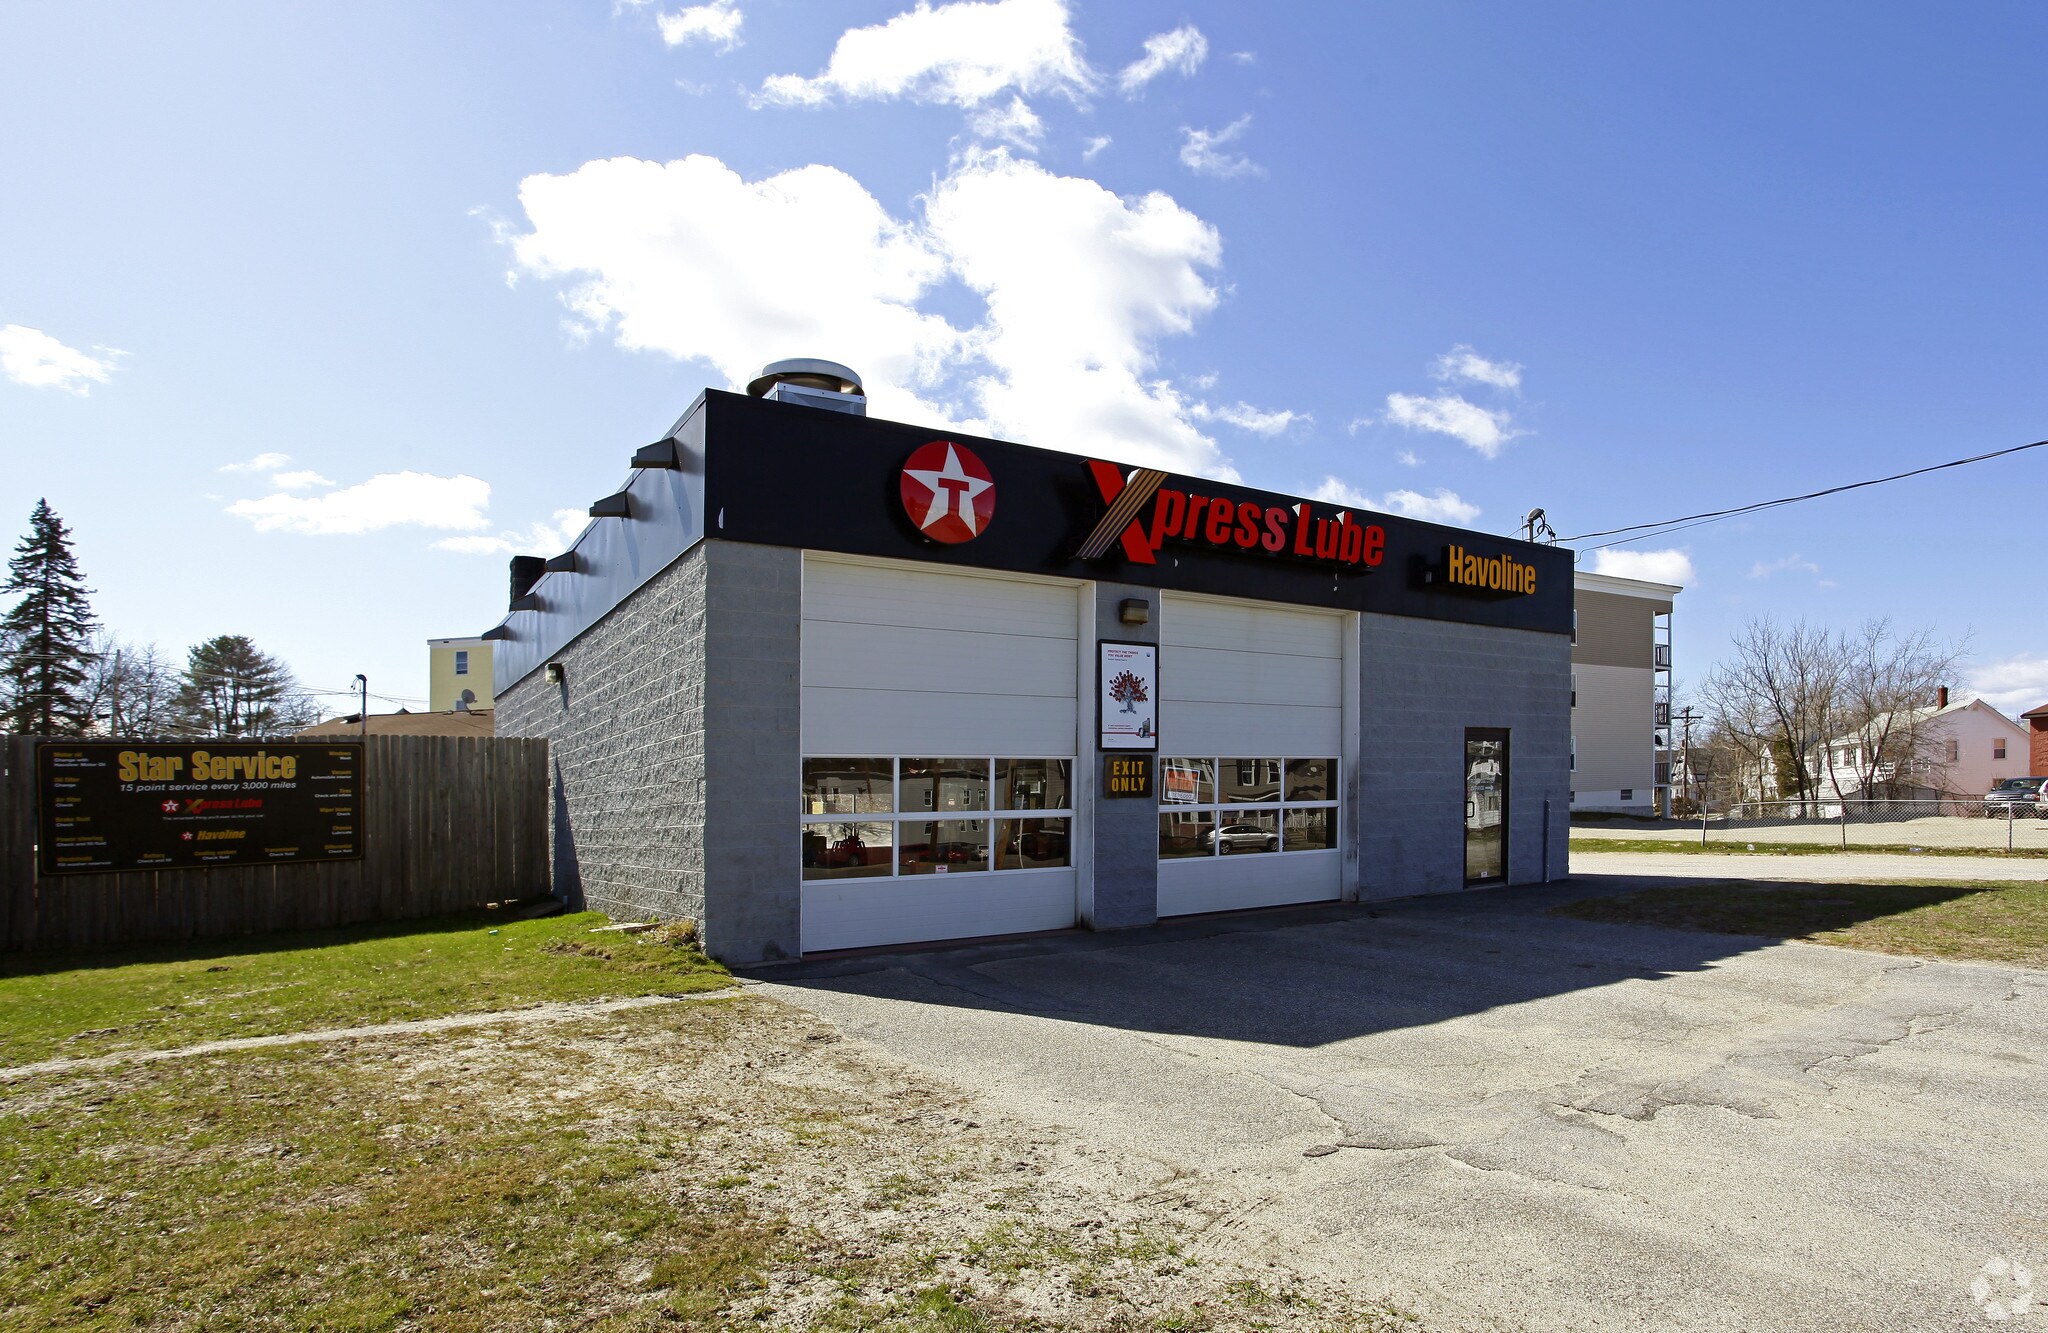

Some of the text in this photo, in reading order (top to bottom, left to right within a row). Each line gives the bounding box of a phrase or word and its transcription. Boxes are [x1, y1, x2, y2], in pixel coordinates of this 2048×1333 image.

[1075, 459, 1386, 567] Xpress Lube
[1449, 544, 1536, 595] Havoline
[118, 750, 296, 781] Star Service
[1113, 761, 1144, 776] EXIT
[136, 784, 165, 792] point
[169, 783, 208, 791] service
[211, 783, 239, 792] every
[241, 782, 268, 790] 3,000
[1111, 777, 1146, 792] ONLY
[197, 829, 246, 840] Havoline
